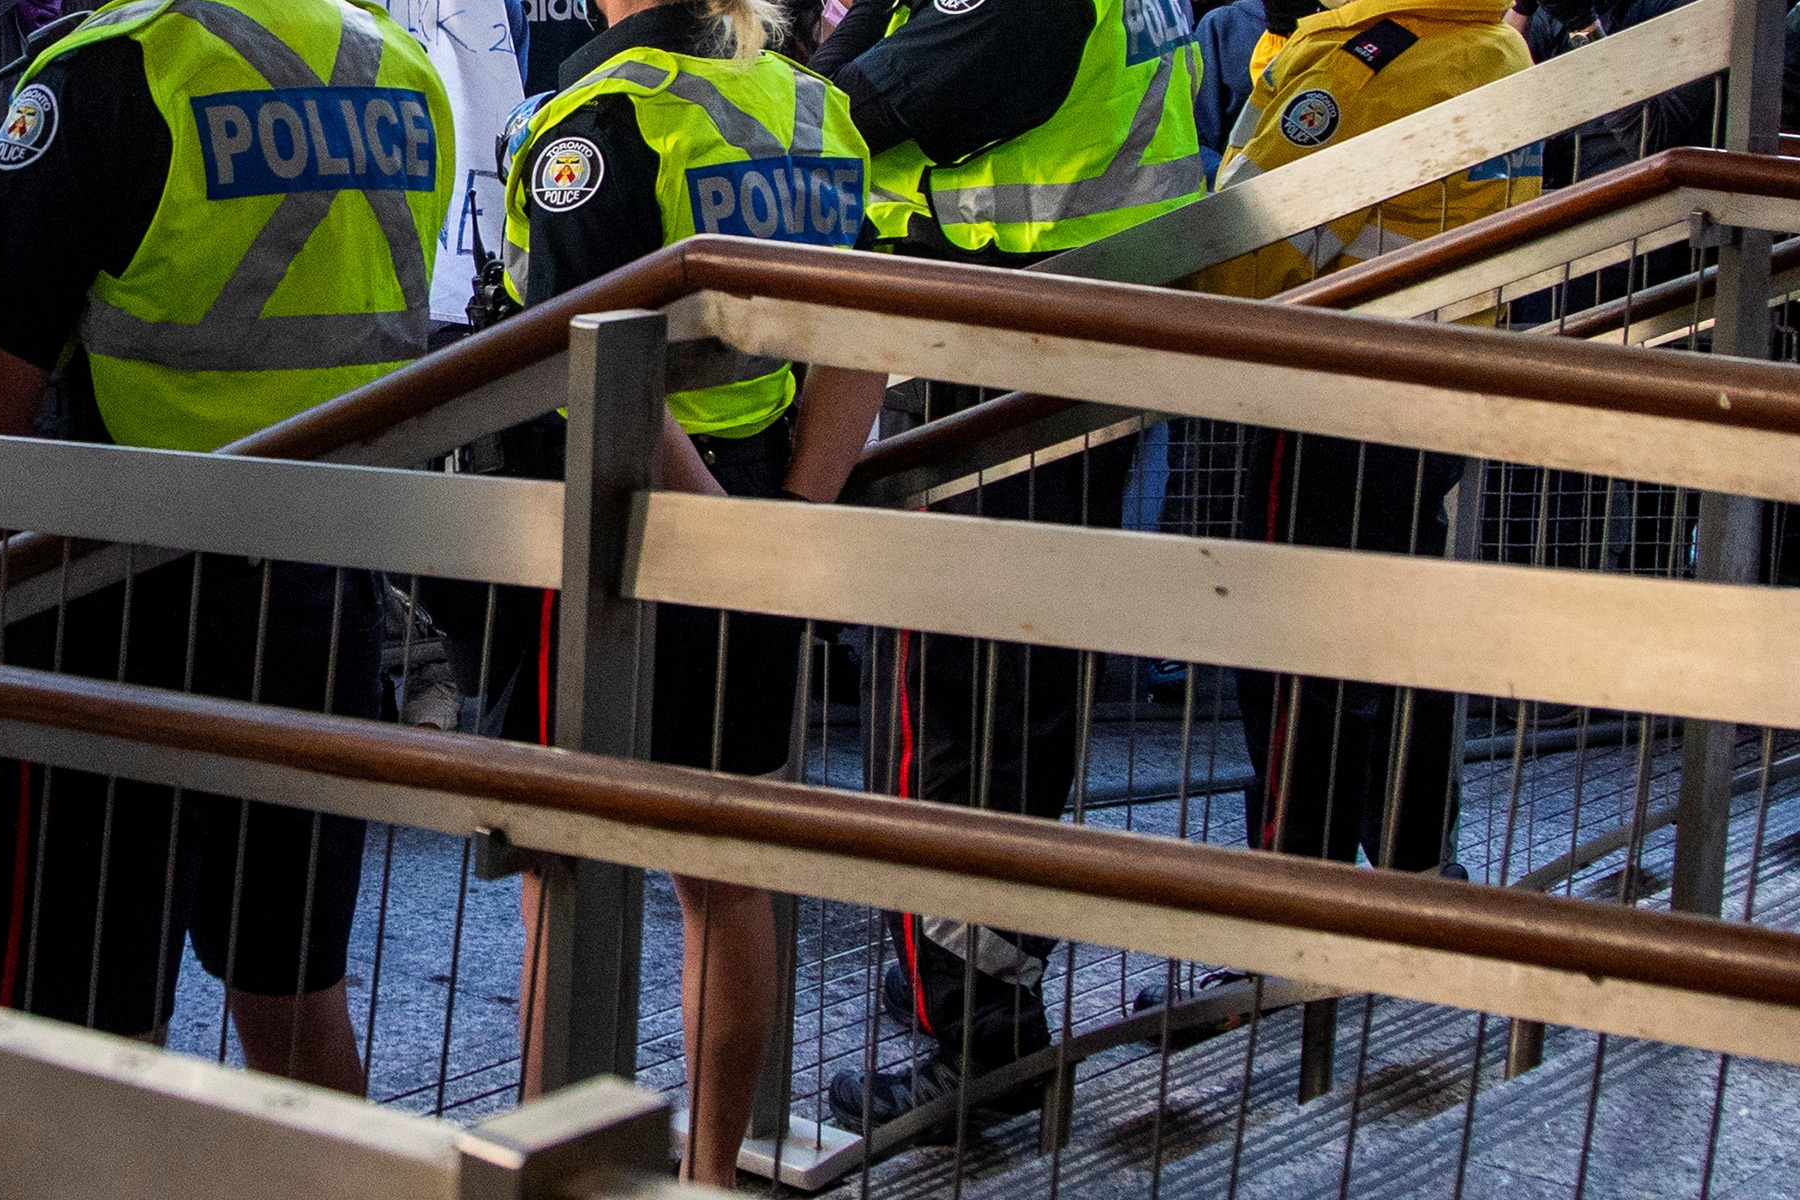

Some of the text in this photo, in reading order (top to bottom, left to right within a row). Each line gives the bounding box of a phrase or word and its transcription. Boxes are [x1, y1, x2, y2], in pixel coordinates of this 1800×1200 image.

[1305, 92, 1338, 118] TORONTO
[204, 98, 430, 185] POLICE
[1284, 121, 1311, 144] POLICE
[546, 141, 594, 159] TORONTO
[544, 190, 580, 206] POLICE
